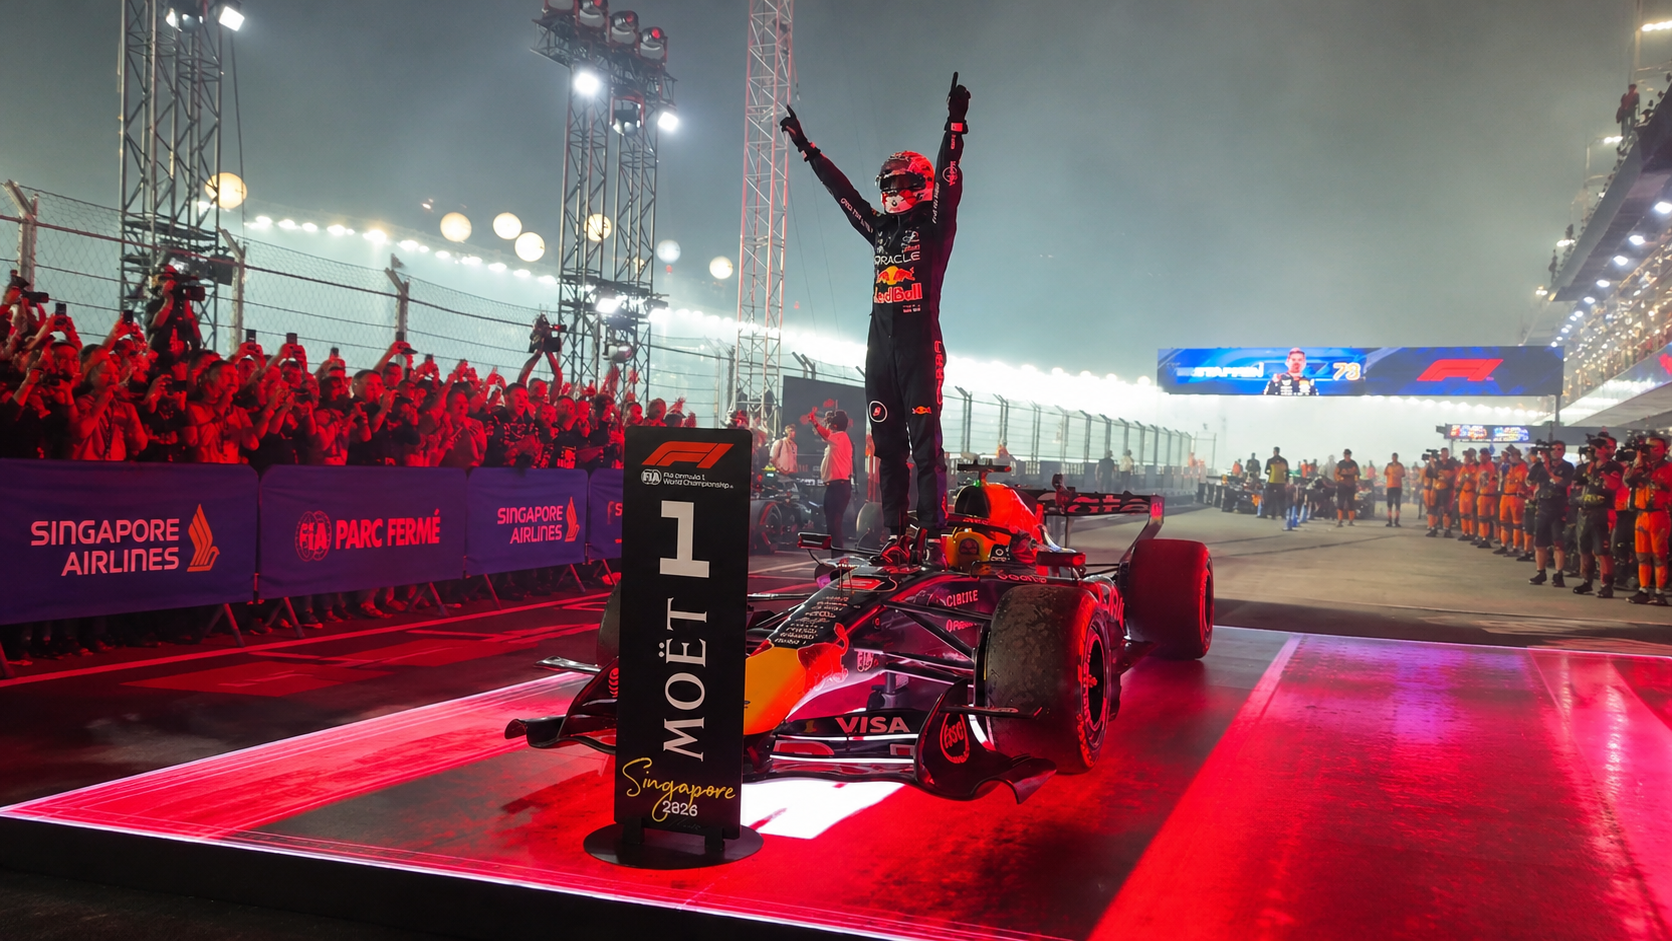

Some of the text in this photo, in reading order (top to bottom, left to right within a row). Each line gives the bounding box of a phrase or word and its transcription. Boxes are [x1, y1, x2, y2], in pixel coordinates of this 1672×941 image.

[874, 251, 921, 265] ORACLE
[1416, 358, 1504, 381] F1
[641, 440, 735, 469] F1
[335, 508, 441, 549] PARC FERMÉ
[497, 505, 564, 525] SINGAPORE
[30, 518, 180, 546] SINGAPORE
[509, 525, 563, 545] AIRLINES
[659, 500, 710, 578] 1
[61, 547, 180, 577] AIRLINES
[658, 596, 708, 762] MOËT
[834, 716, 911, 733] VISA
[622, 757, 736, 822] Singapore
